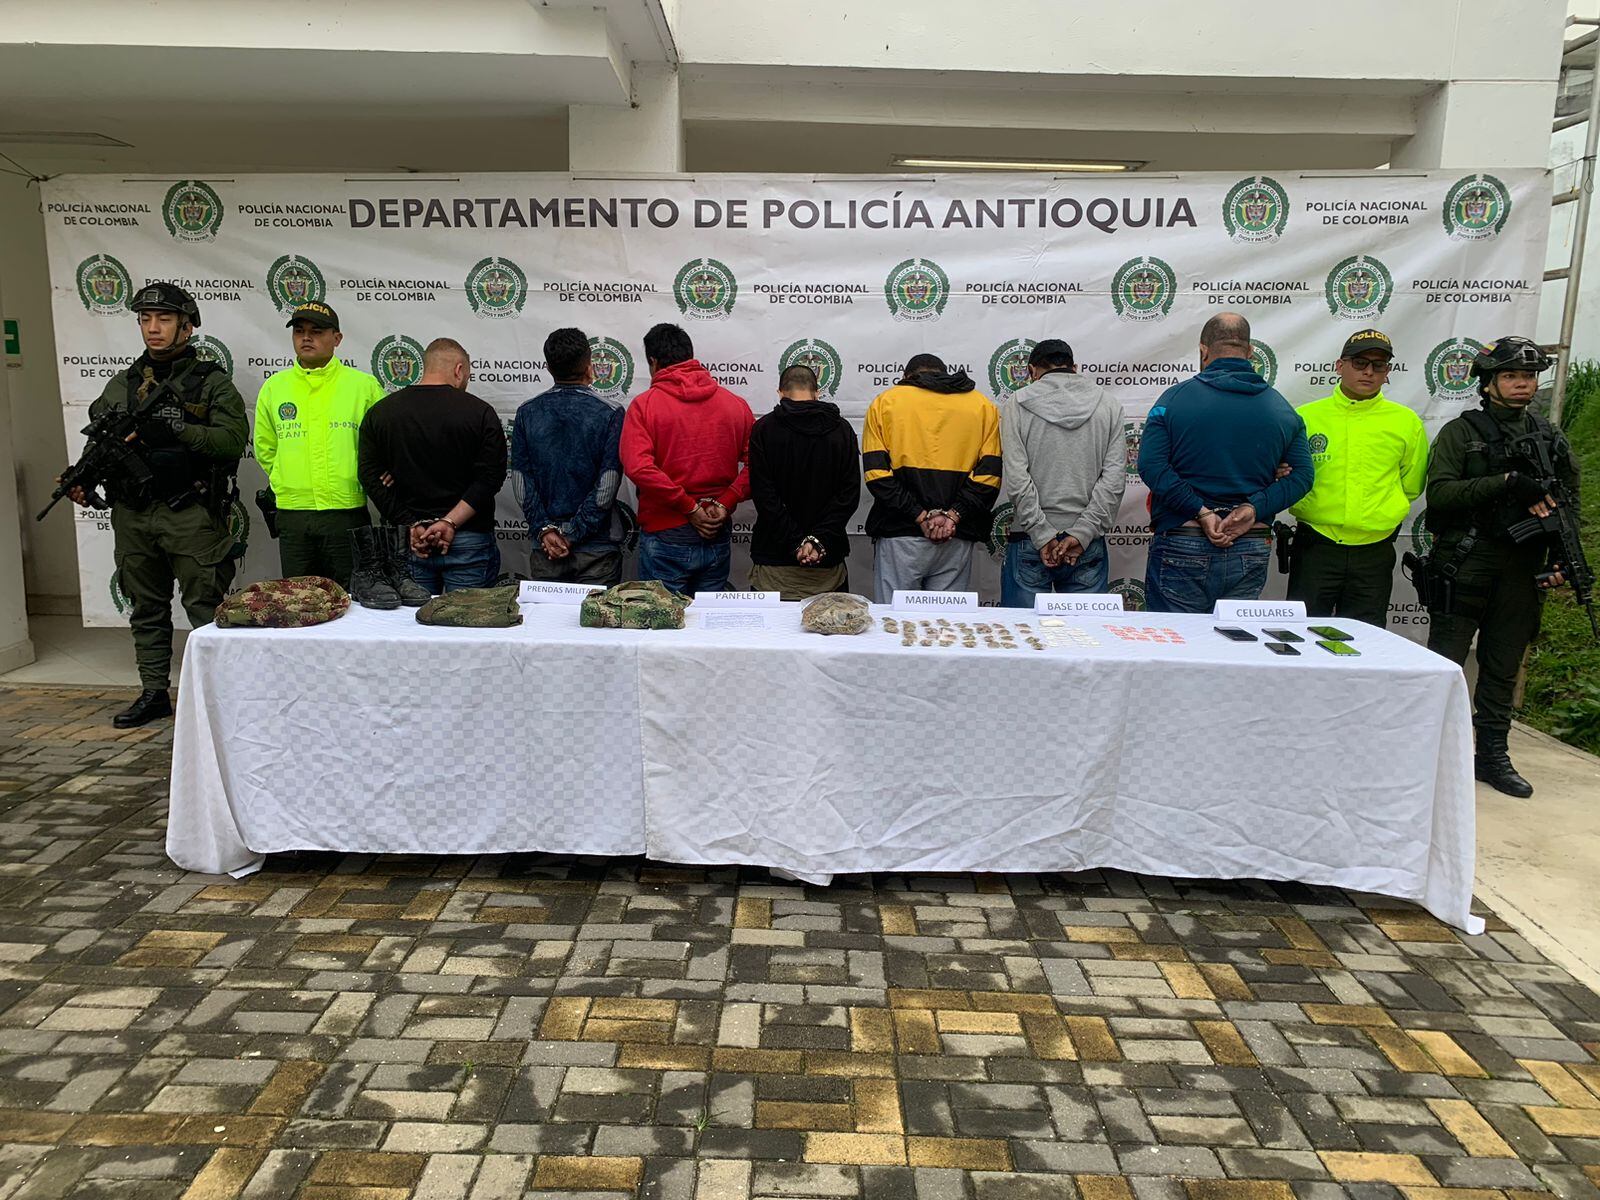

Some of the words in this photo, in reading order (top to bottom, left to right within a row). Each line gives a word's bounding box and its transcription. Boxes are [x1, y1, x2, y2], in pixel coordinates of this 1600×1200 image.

[48, 203, 92, 212] POLICÍA
[94, 204, 151, 213] NACIONAL
[239, 203, 283, 213] POLICÍA
[286, 205, 346, 213] NACIONAL
[1307, 200, 1356, 211] POLICÍA
[1361, 201, 1427, 210] NACIONAL
[349, 198, 679, 228] DEPARTAMENTO
[695, 200, 747, 228] DE
[763, 191, 934, 228] POLICÍA
[942, 198, 1197, 234] ANTIOQUIA
[64, 217, 77, 225] DE
[79, 217, 139, 226] COLOMBIA
[255, 218, 269, 226] DE
[273, 218, 333, 227] COLOMBIA
[1323, 216, 1338, 224] DE
[1343, 215, 1409, 224] COLOMBIA
[196, 280, 254, 288] NACIONAL
[340, 278, 386, 288] POLICÍA
[388, 280, 450, 289] NACIONAL
[544, 281, 590, 292] POLICÍA
[594, 284, 657, 293] NACIONAL
[754, 283, 801, 293] POLICÍA
[805, 285, 869, 293] NACIONAL
[966, 281, 1014, 292] POLICÍA
[1018, 283, 1083, 292] NACIONAL
[1193, 280, 1241, 291] POLICÍA
[1245, 282, 1309, 290] NACIONAL
[1413, 278, 1459, 289] POLICÍA
[1463, 280, 1528, 289] NACIONAL
[190, 292, 241, 300] OLOMBIA
[357, 293, 371, 301] DE
[375, 292, 435, 301] COLOMBIA
[560, 292, 574, 301] DE
[578, 292, 642, 302] COLOMBIA
[770, 295, 785, 303] DE
[789, 295, 853, 304] COLOMBIA
[982, 295, 997, 303] DE
[1001, 294, 1066, 304] COLOMBIA
[1209, 295, 1224, 304] DE
[1228, 295, 1291, 304] COLOMBIA
[1426, 294, 1441, 302] DE
[1444, 293, 1511, 302] COLOMBIA
[64, 354, 108, 364] POLICÍA
[248, 356, 294, 366] POLICÍA
[858, 362, 904, 372] POLICÍA
[1082, 362, 1128, 372] POLICÍA
[1132, 364, 1196, 372] NACIONAL
[80, 369, 96, 377] DE
[479, 374, 541, 382] COLOMBIA
[874, 377, 888, 386] DE
[1096, 377, 1111, 386] DE
[1115, 377, 1179, 386] COLOMBIA
[1310, 376, 1325, 385] DE
[526, 585, 564, 594] PRENDAS
[905, 596, 967, 605] MARIHUANA
[1047, 602, 1072, 611] BASE
[1076, 603, 1089, 611] DE
[1092, 602, 1120, 611] COCA
[1388, 602, 1424, 612] OLICÍA
[1236, 608, 1294, 618] CELULARES
[1392, 616, 1408, 624] DE
